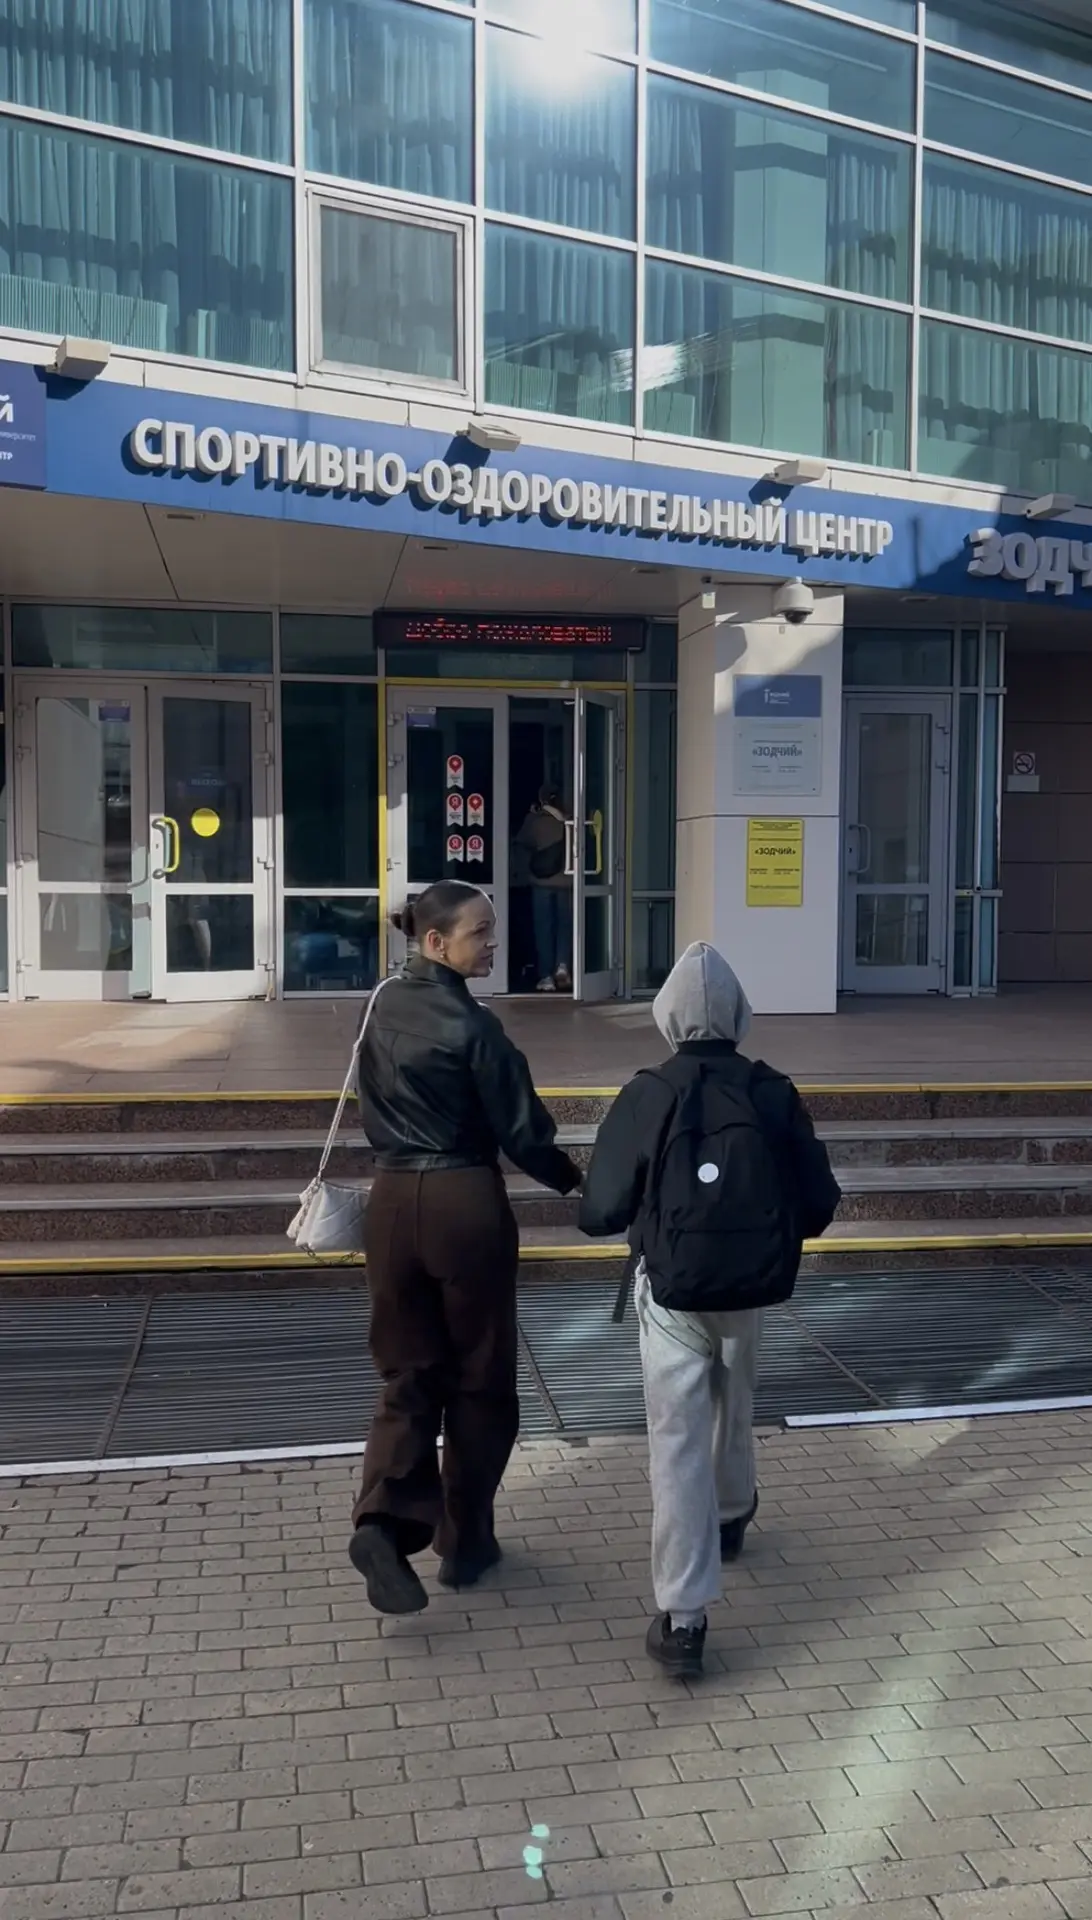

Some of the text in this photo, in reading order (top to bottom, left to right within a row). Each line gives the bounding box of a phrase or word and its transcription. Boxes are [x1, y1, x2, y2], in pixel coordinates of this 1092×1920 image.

[131, 417, 894, 556] СПОРТИВНО-ОЗДОРОВИТЕЛЬНЫЙ ЦЕНТР
[752, 744, 803, 759] «ЗОДЧИЙ»
[754, 846, 796, 857] «ЗОДЧИЙ»
